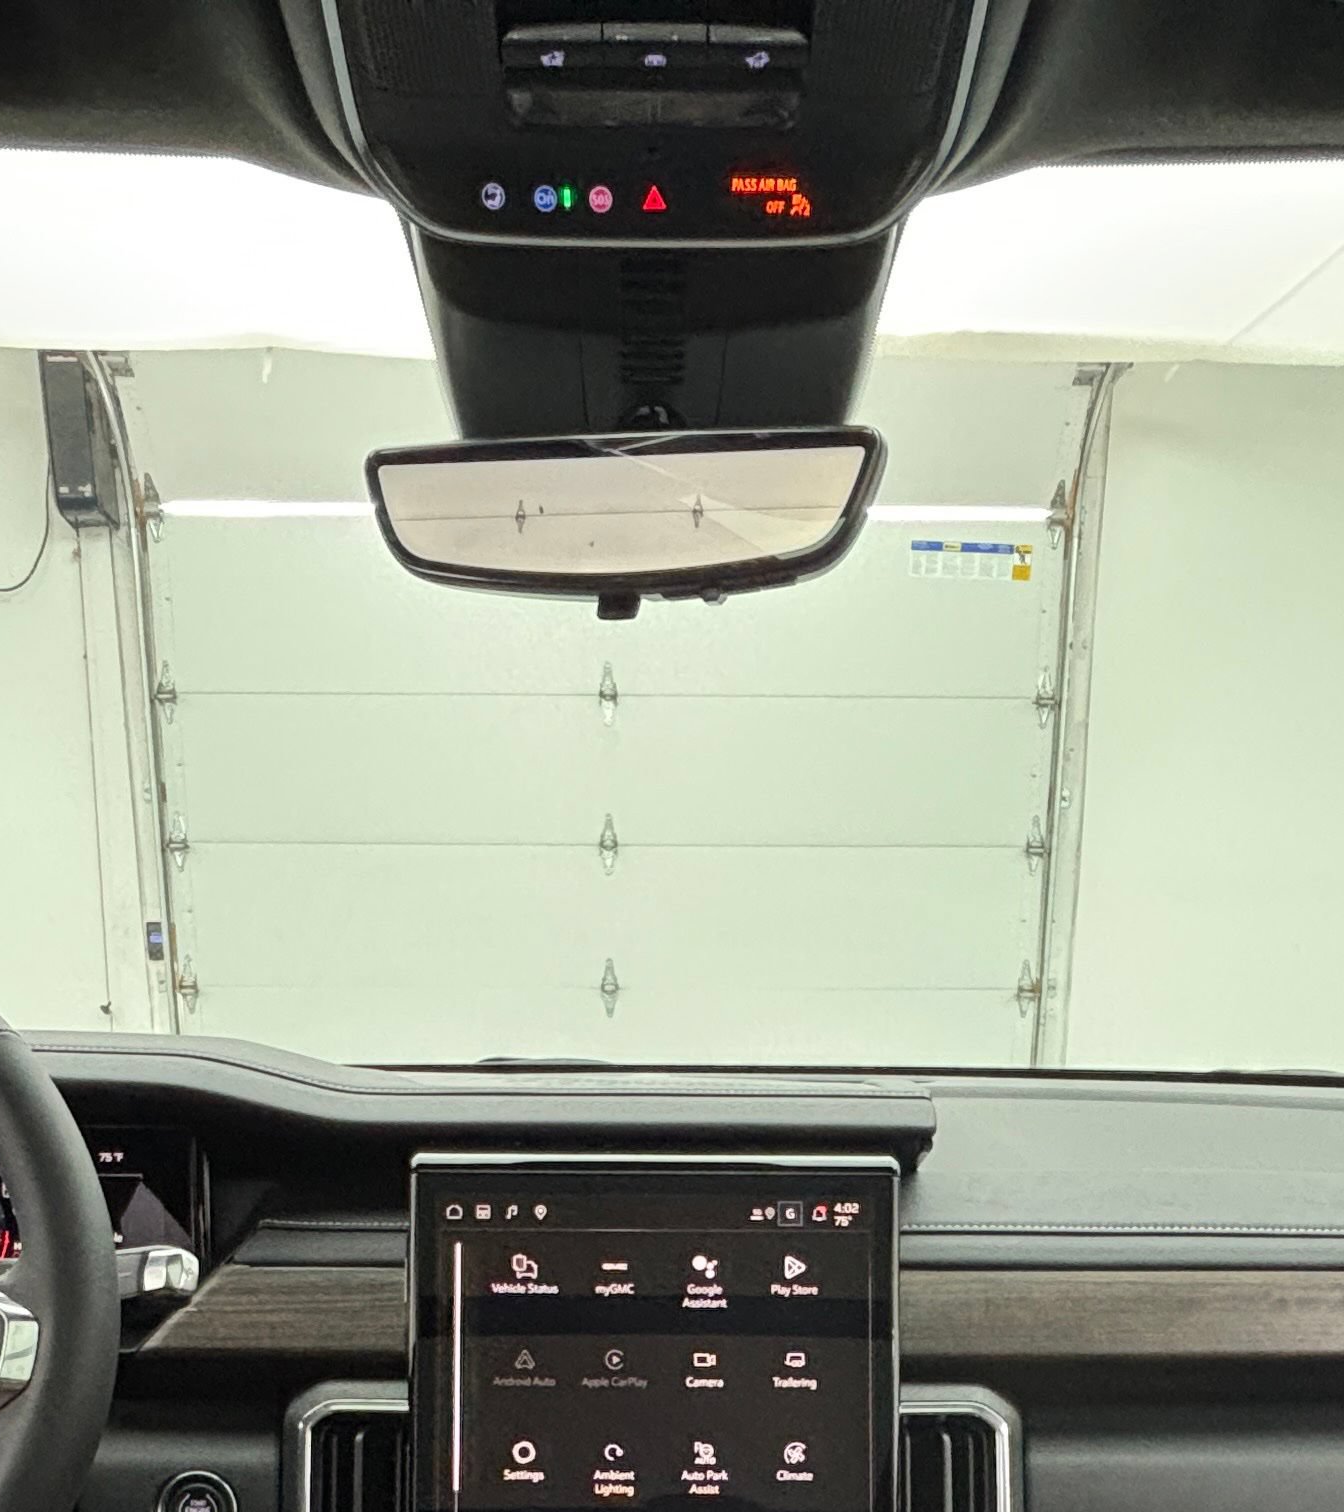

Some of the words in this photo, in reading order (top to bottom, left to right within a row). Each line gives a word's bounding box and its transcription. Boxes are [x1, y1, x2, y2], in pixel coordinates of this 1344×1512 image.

[731, 178, 757, 191] PASS
[758, 178, 775, 191] AIR
[776, 178, 797, 191] BAG
[591, 193, 610, 206] SOS
[766, 200, 786, 213] OFF
[833, 1202, 860, 1214] 4:02
[491, 1283, 526, 1294] Vehicle
[527, 1283, 559, 1294] Status
[594, 1283, 635, 1297] myGMC
[687, 1283, 723, 1297] Google
[770, 1284, 791, 1297] Play
[792, 1284, 818, 1295] Store
[682, 1297, 727, 1309] Assistant
[492, 1376, 527, 1388] Android
[529, 1376, 556, 1388] Auto
[581, 1376, 609, 1390] Apple
[610, 1376, 648, 1390] CarPlay
[685, 1377, 724, 1389] Camera
[772, 1376, 817, 1390] Trailering
[503, 1469, 545, 1483] Settings
[593, 1469, 635, 1482] Ambient
[681, 1469, 705, 1482] Auto
[706, 1469, 728, 1482] Park
[776, 1469, 814, 1482] Climate
[594, 1483, 634, 1498] Lighting
[689, 1483, 720, 1496] Assist
